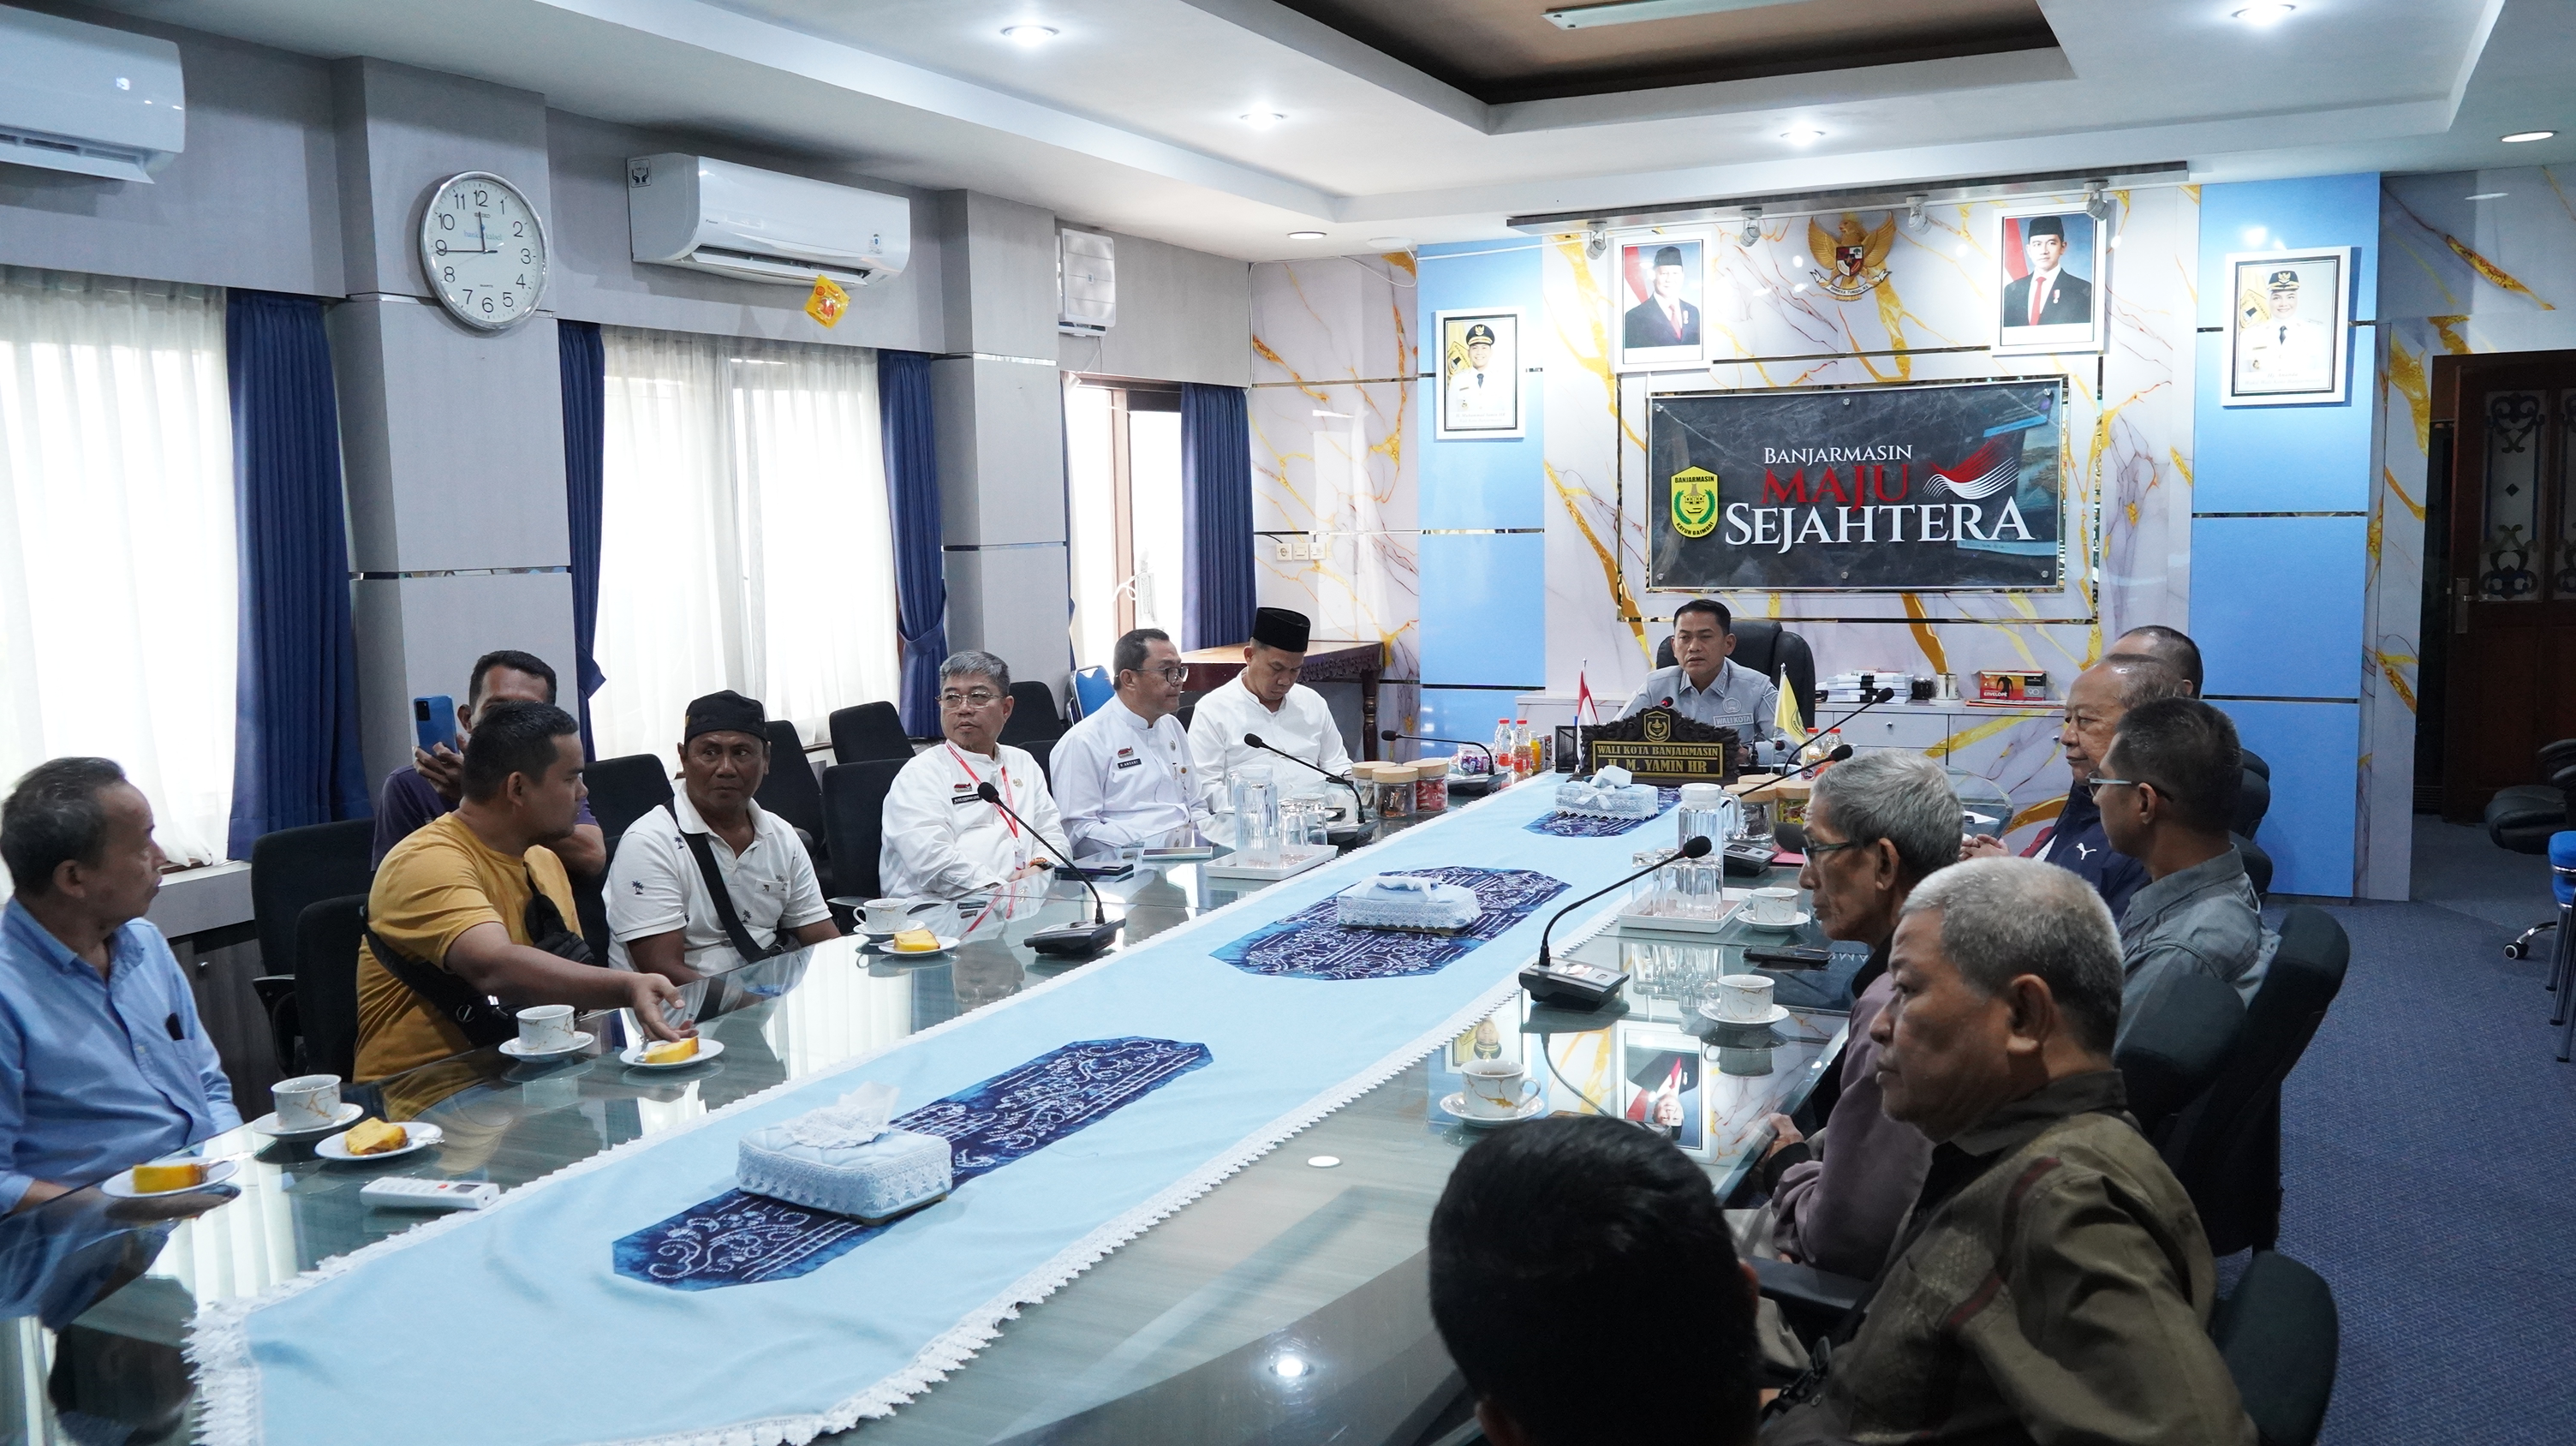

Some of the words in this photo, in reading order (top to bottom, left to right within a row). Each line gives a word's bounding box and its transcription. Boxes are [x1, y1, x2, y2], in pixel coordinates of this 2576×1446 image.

[455, 193, 466, 210] 11
[474, 190, 488, 207] 12
[500, 200, 505, 215] 1
[438, 213, 455, 230] 10
[513, 221, 523, 238] 2
[435, 239, 447, 256] 9
[521, 248, 532, 265] 3
[444, 266, 456, 283] 8
[516, 273, 526, 290] 4
[462, 289, 473, 305] 7
[481, 297, 494, 314] 6
[503, 292, 514, 308] 5
[1764, 444, 1913, 466] BANJARMASIN
[1761, 463, 1909, 512] MAJU
[1725, 495, 2037, 554] SEJAHTERA
[1733, 715, 1751, 724] KOTA
[1597, 745, 1620, 756] WALI
[1623, 745, 1649, 756] KOTA
[1652, 746, 1719, 756] BANJARMASIN
[1625, 759, 1640, 772] M.
[1644, 759, 1685, 773] YAMIN
[1688, 760, 1708, 773] HR
